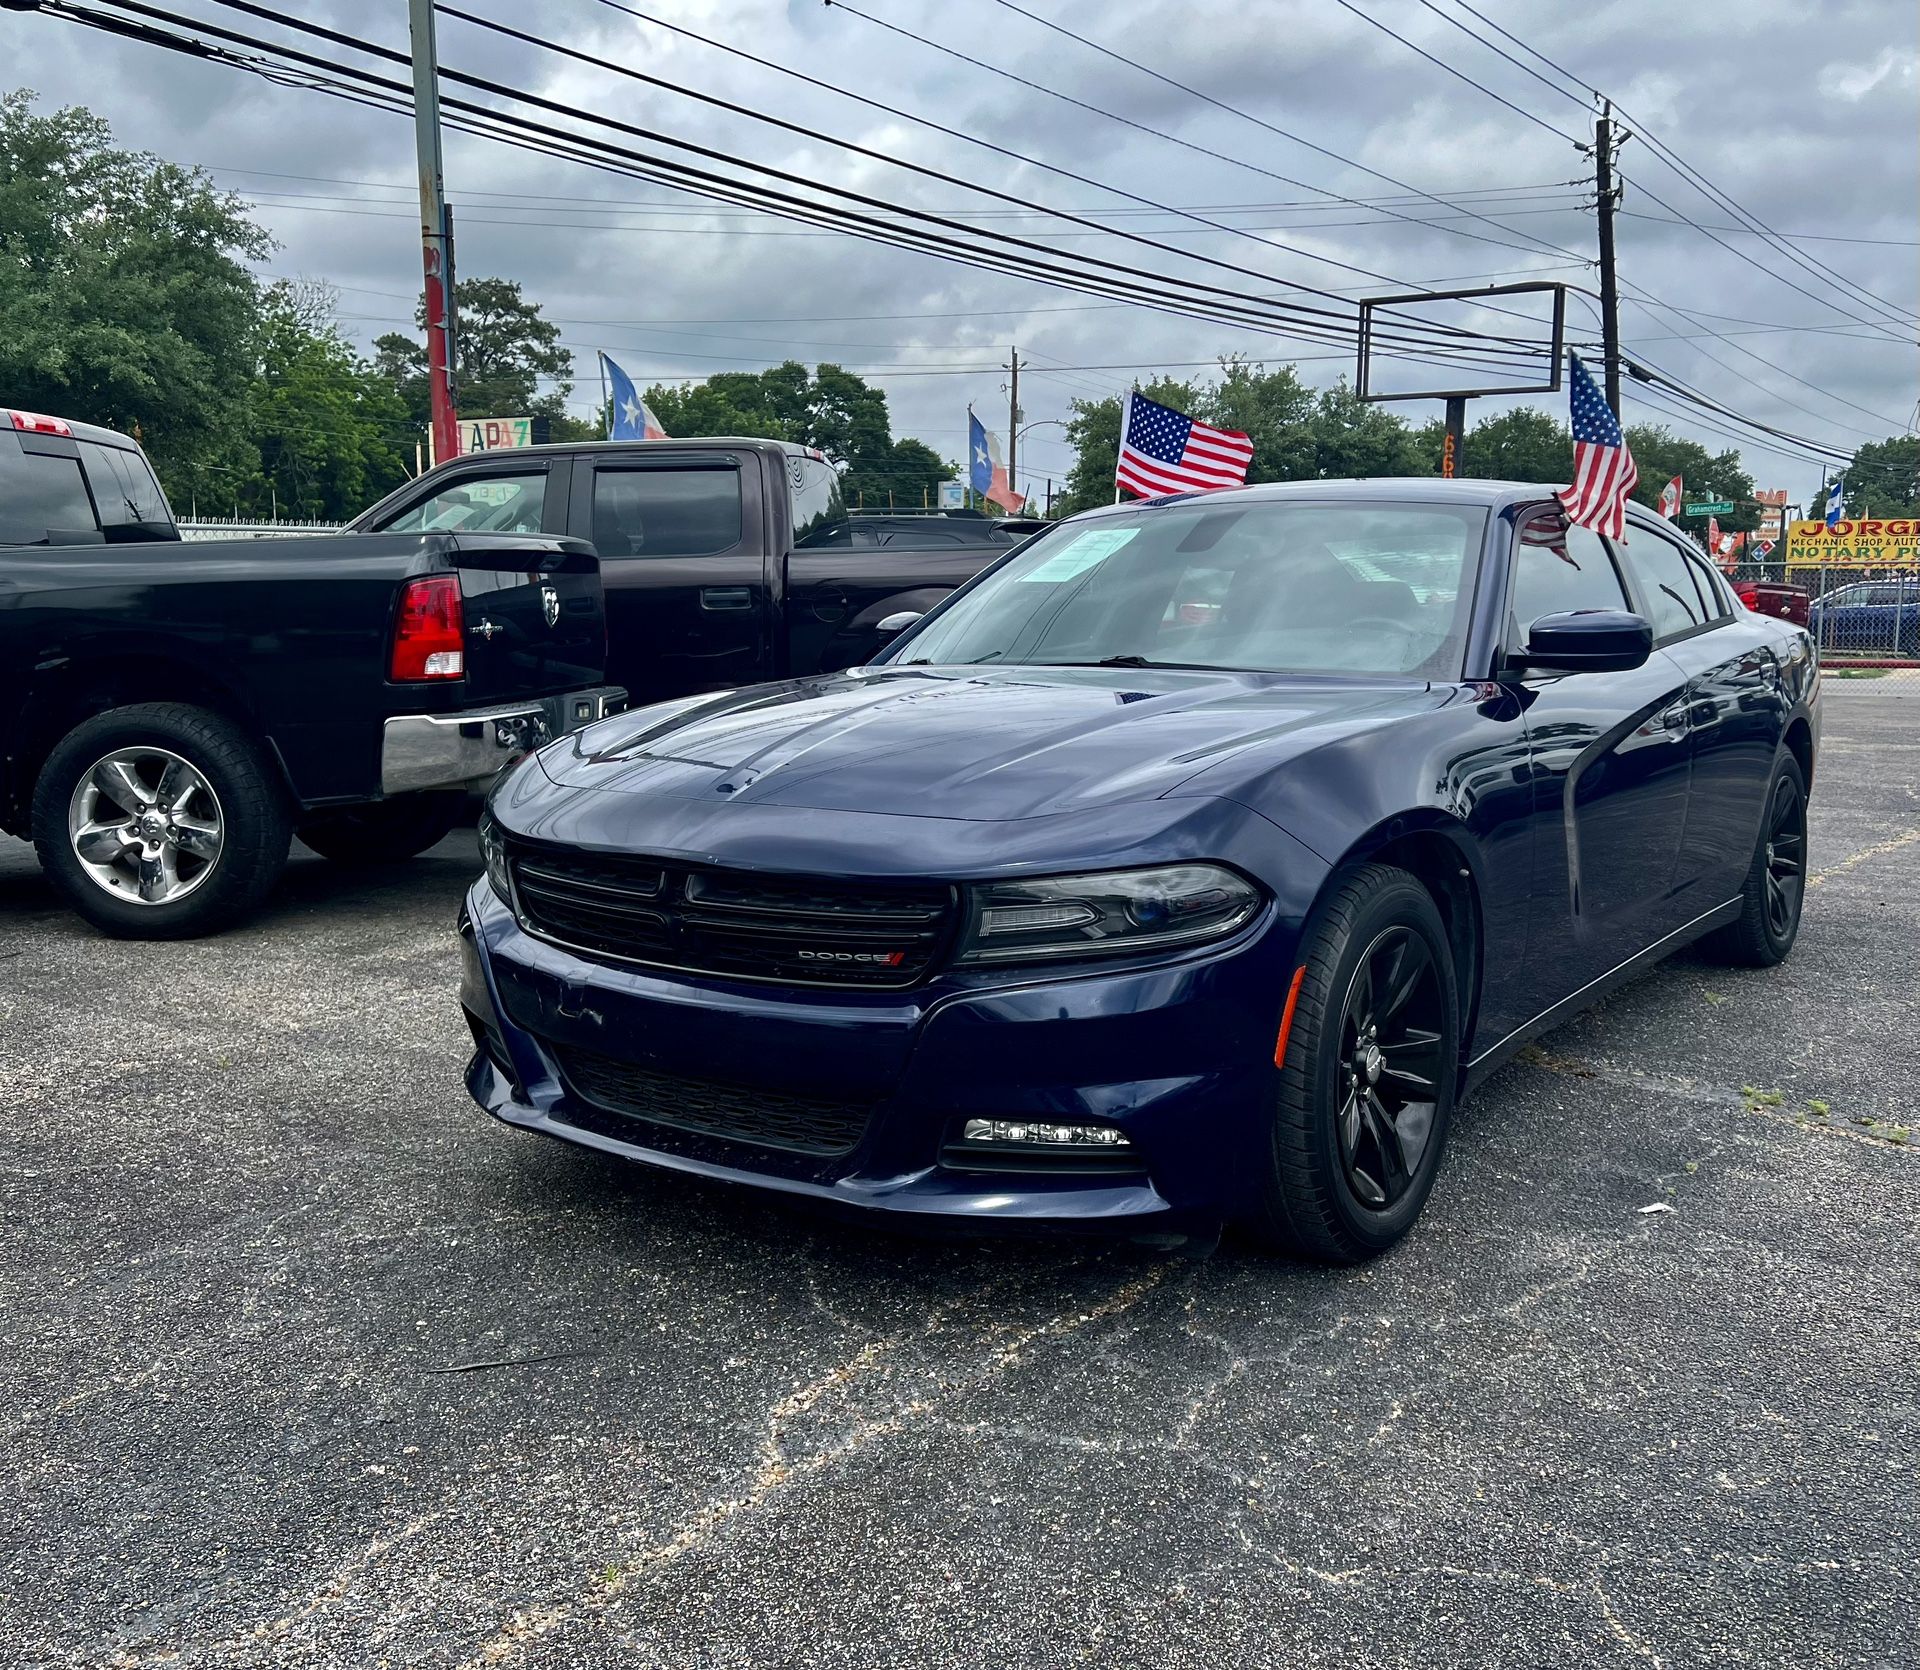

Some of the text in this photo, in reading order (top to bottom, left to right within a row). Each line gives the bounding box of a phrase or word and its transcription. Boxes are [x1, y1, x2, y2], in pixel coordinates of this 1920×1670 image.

[1688, 504, 1722, 514] Grahamcrest
[1791, 538, 1849, 546] MECHANIC
[1854, 538, 1882, 546] SHOP
[1885, 538, 1891, 546] &
[1790, 547, 1886, 558] NOTARY
[798, 951, 891, 962] DODGE
